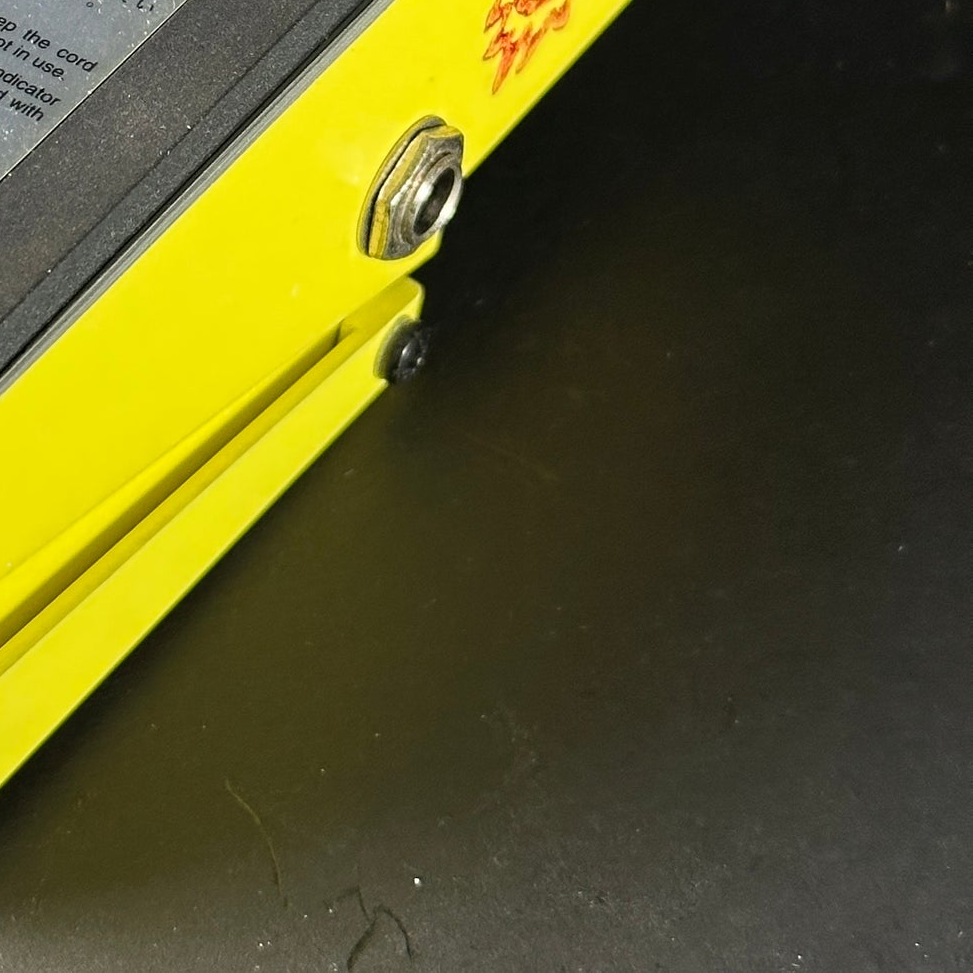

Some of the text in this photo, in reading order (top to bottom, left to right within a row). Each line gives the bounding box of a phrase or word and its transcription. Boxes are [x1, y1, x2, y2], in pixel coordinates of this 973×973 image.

[12, 44, 31, 61] in
[32, 57, 65, 82] use.
[22, 28, 51, 49] the
[56, 48, 99, 73] cord
[9, 98, 44, 122] with
